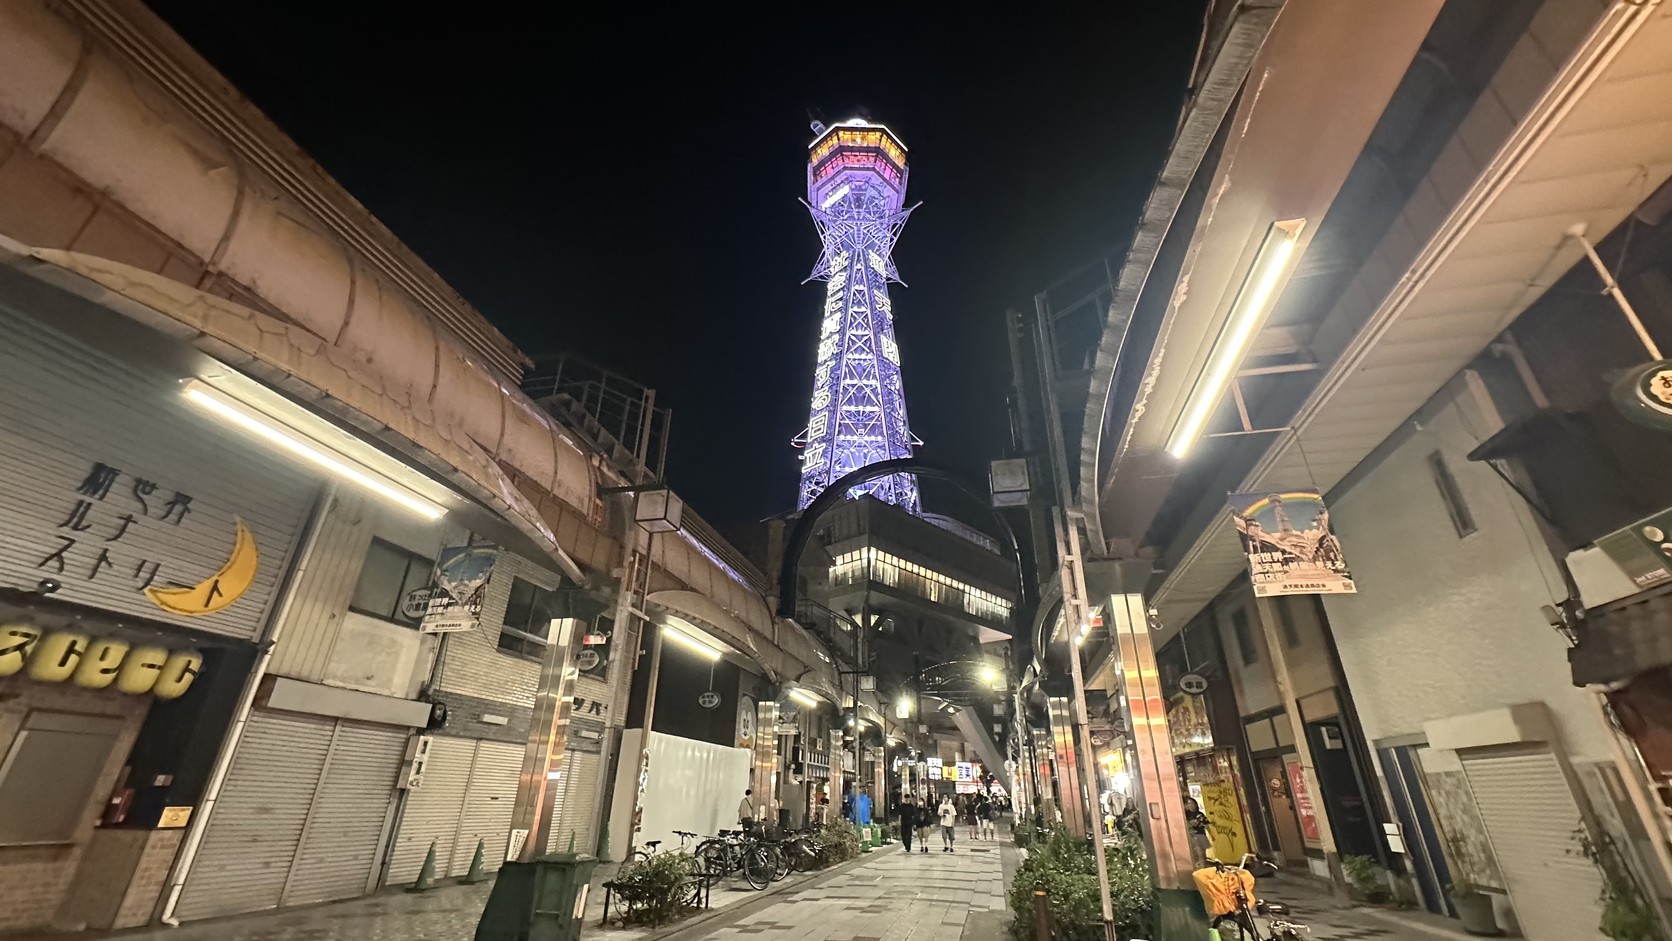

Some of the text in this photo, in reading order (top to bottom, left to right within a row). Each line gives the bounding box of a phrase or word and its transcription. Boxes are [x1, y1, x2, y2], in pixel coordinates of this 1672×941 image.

[57, 500, 138, 542] ルナ
[77, 462, 194, 525] 新世界
[38, 535, 223, 608] ストリート
[0, 629, 198, 688] ストリート
